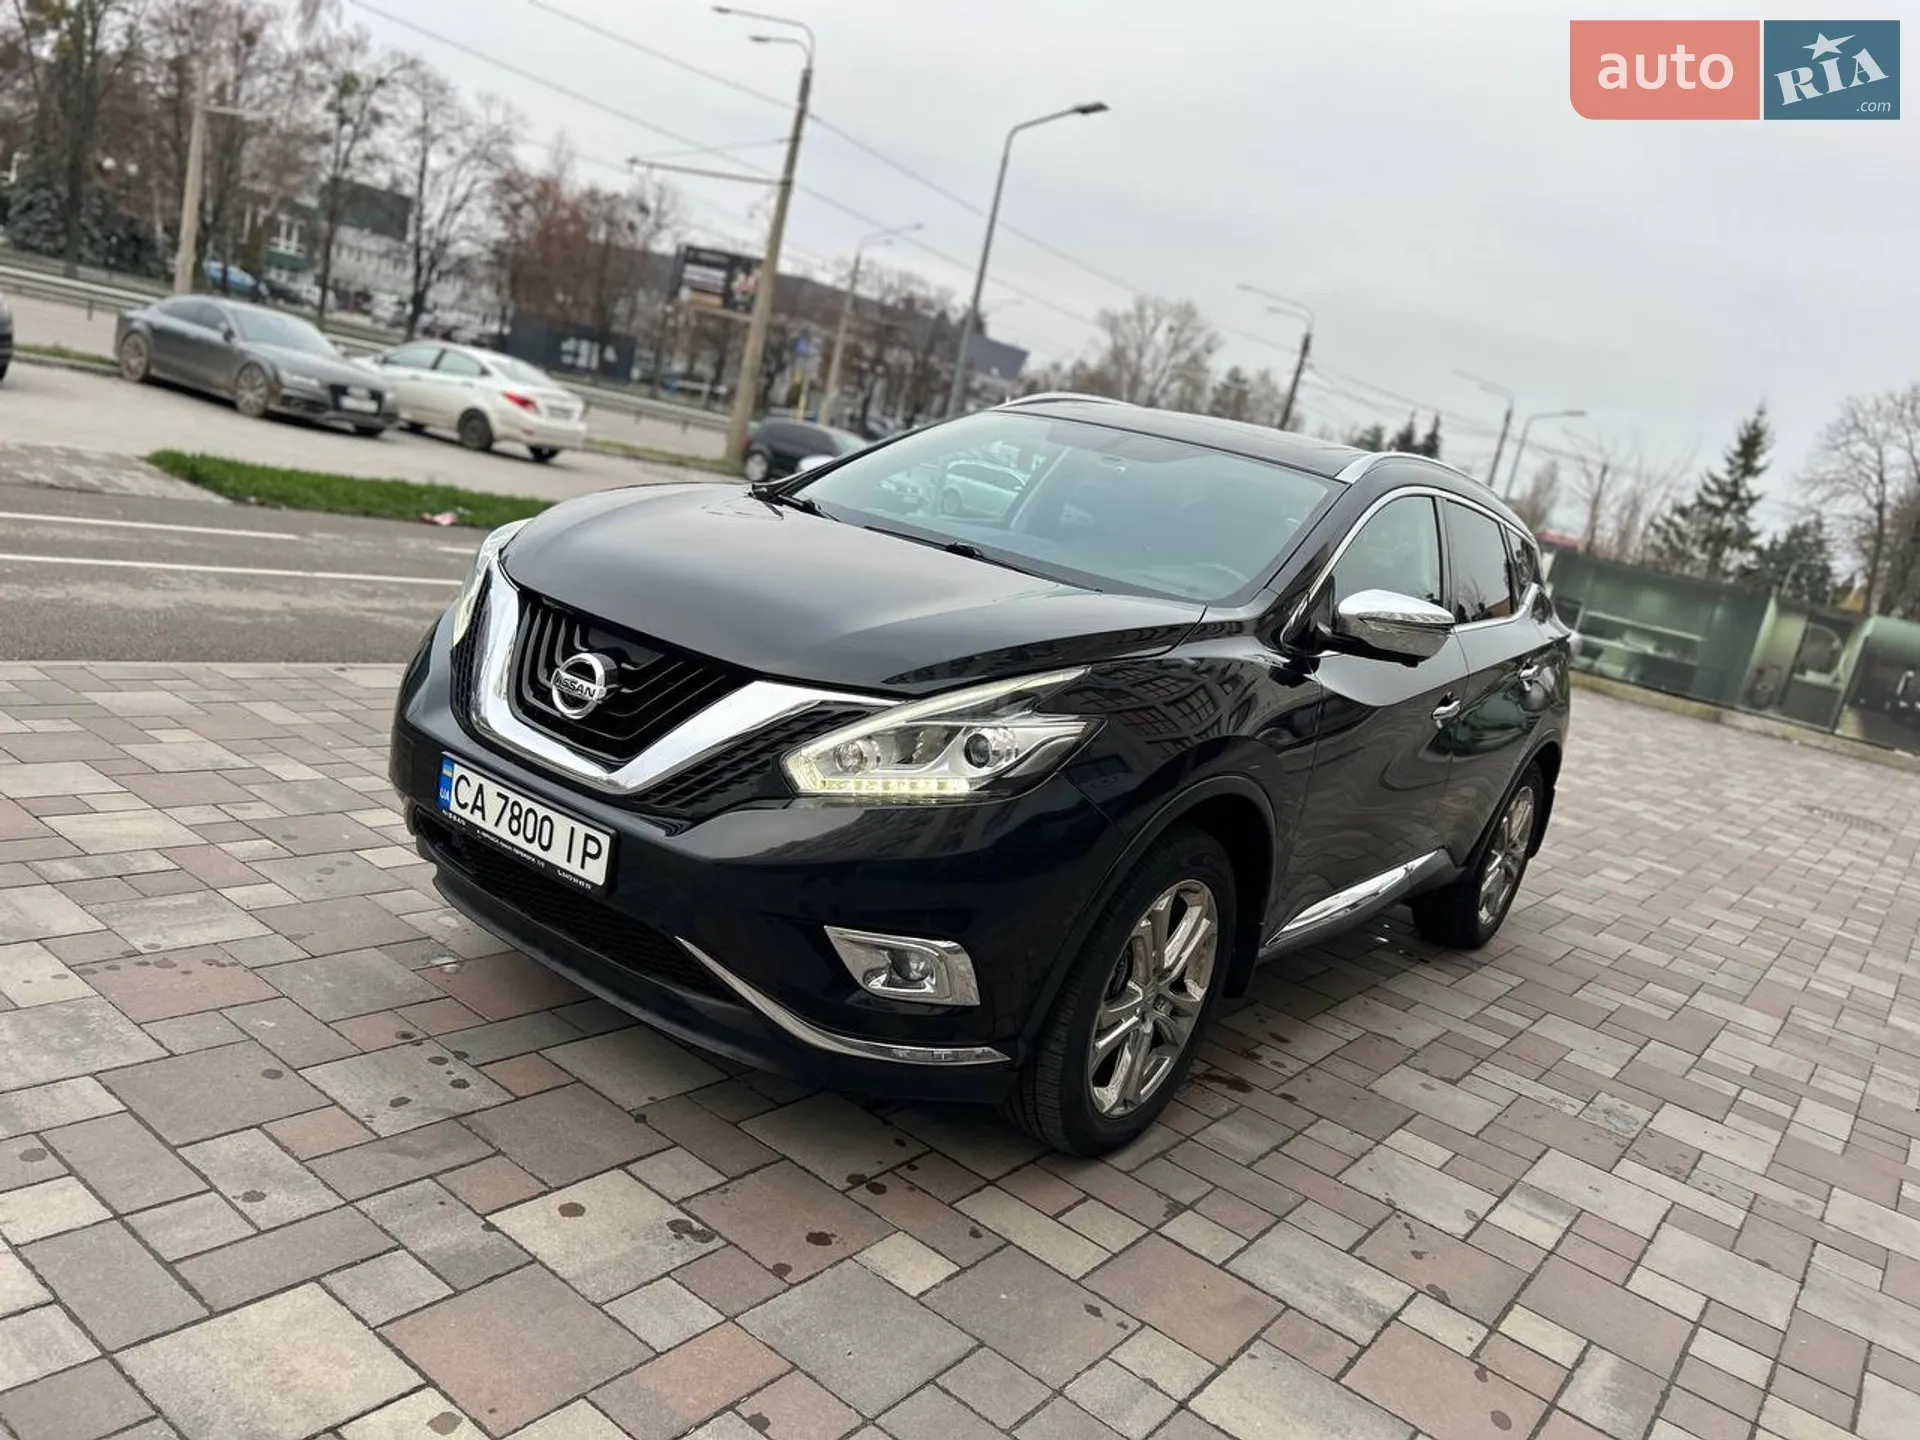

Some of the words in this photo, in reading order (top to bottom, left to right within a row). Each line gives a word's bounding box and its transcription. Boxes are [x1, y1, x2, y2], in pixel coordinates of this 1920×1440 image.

[454, 774, 486, 822] CA
[494, 792, 554, 852] 7800
[566, 826, 603, 870] IP
